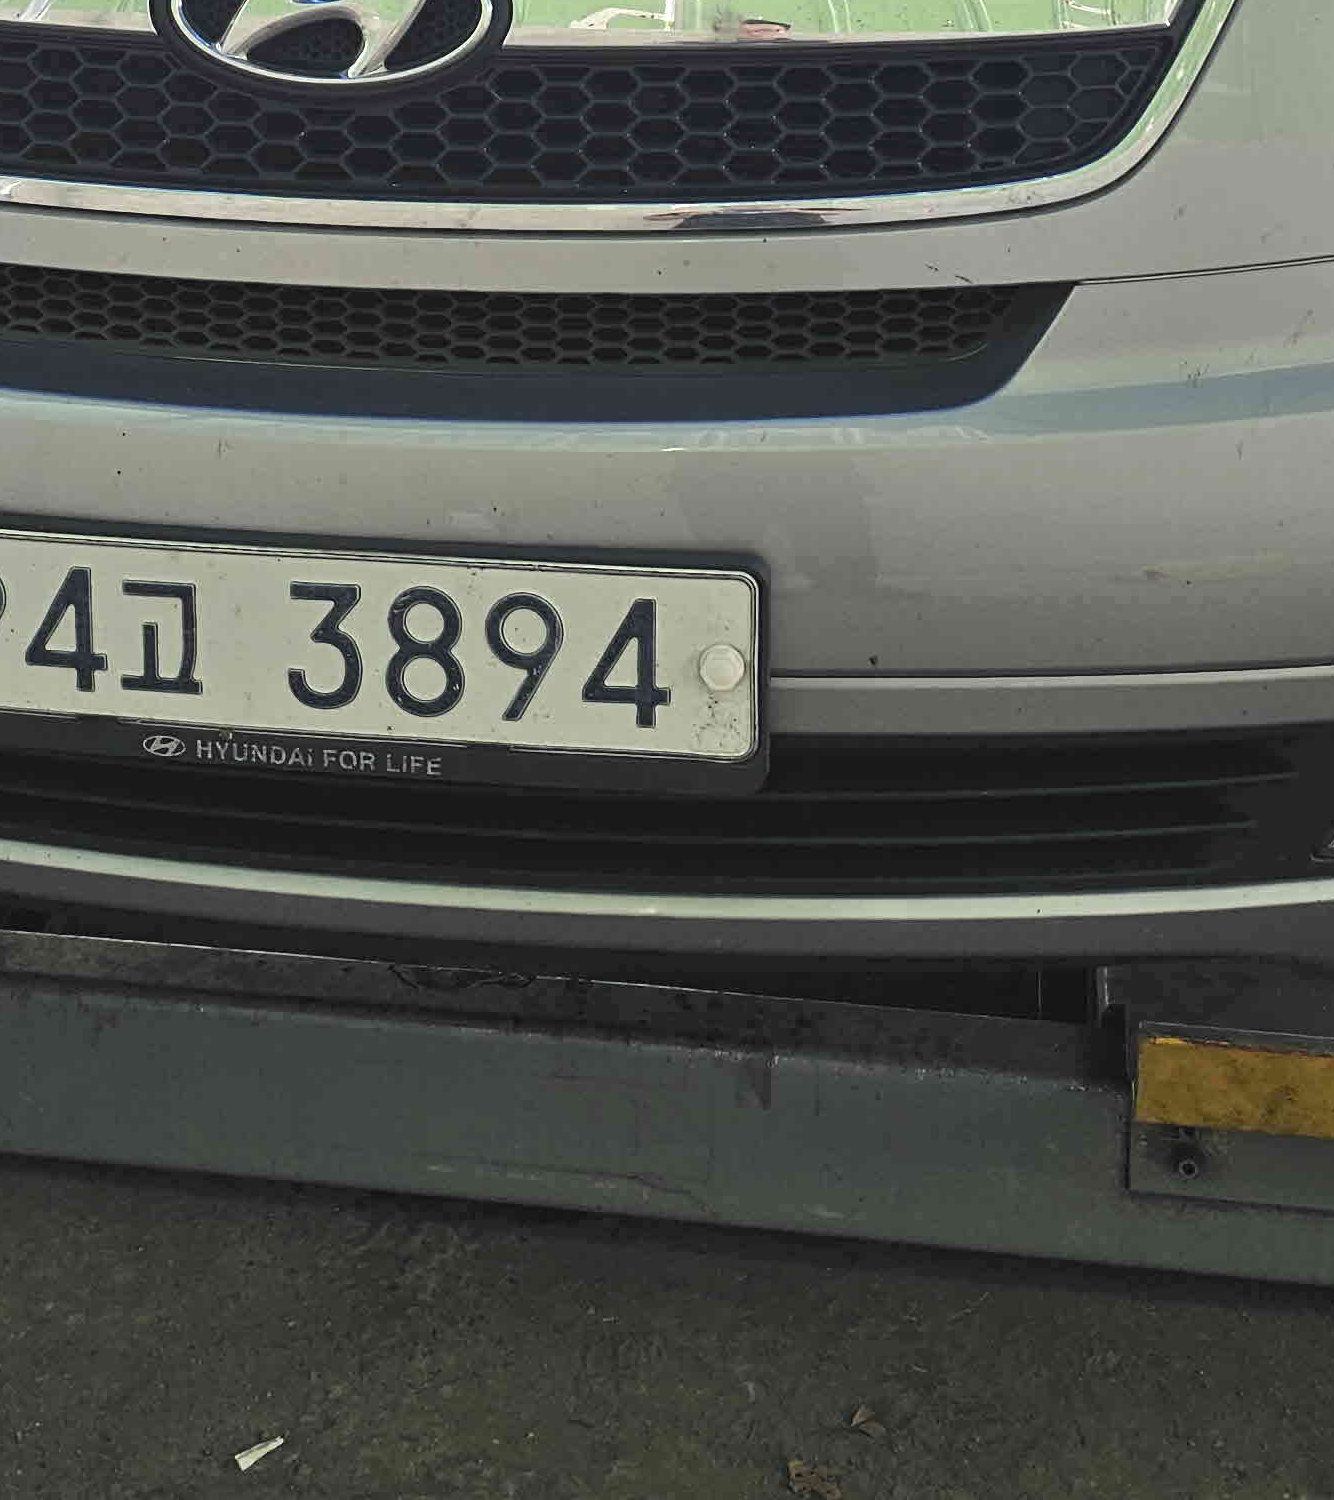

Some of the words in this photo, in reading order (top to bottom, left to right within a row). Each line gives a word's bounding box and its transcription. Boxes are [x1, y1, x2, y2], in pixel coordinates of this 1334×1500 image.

[287, 580, 672, 729] 3894
[322, 749, 377, 772] FOR
[385, 752, 443, 776] LIFE
